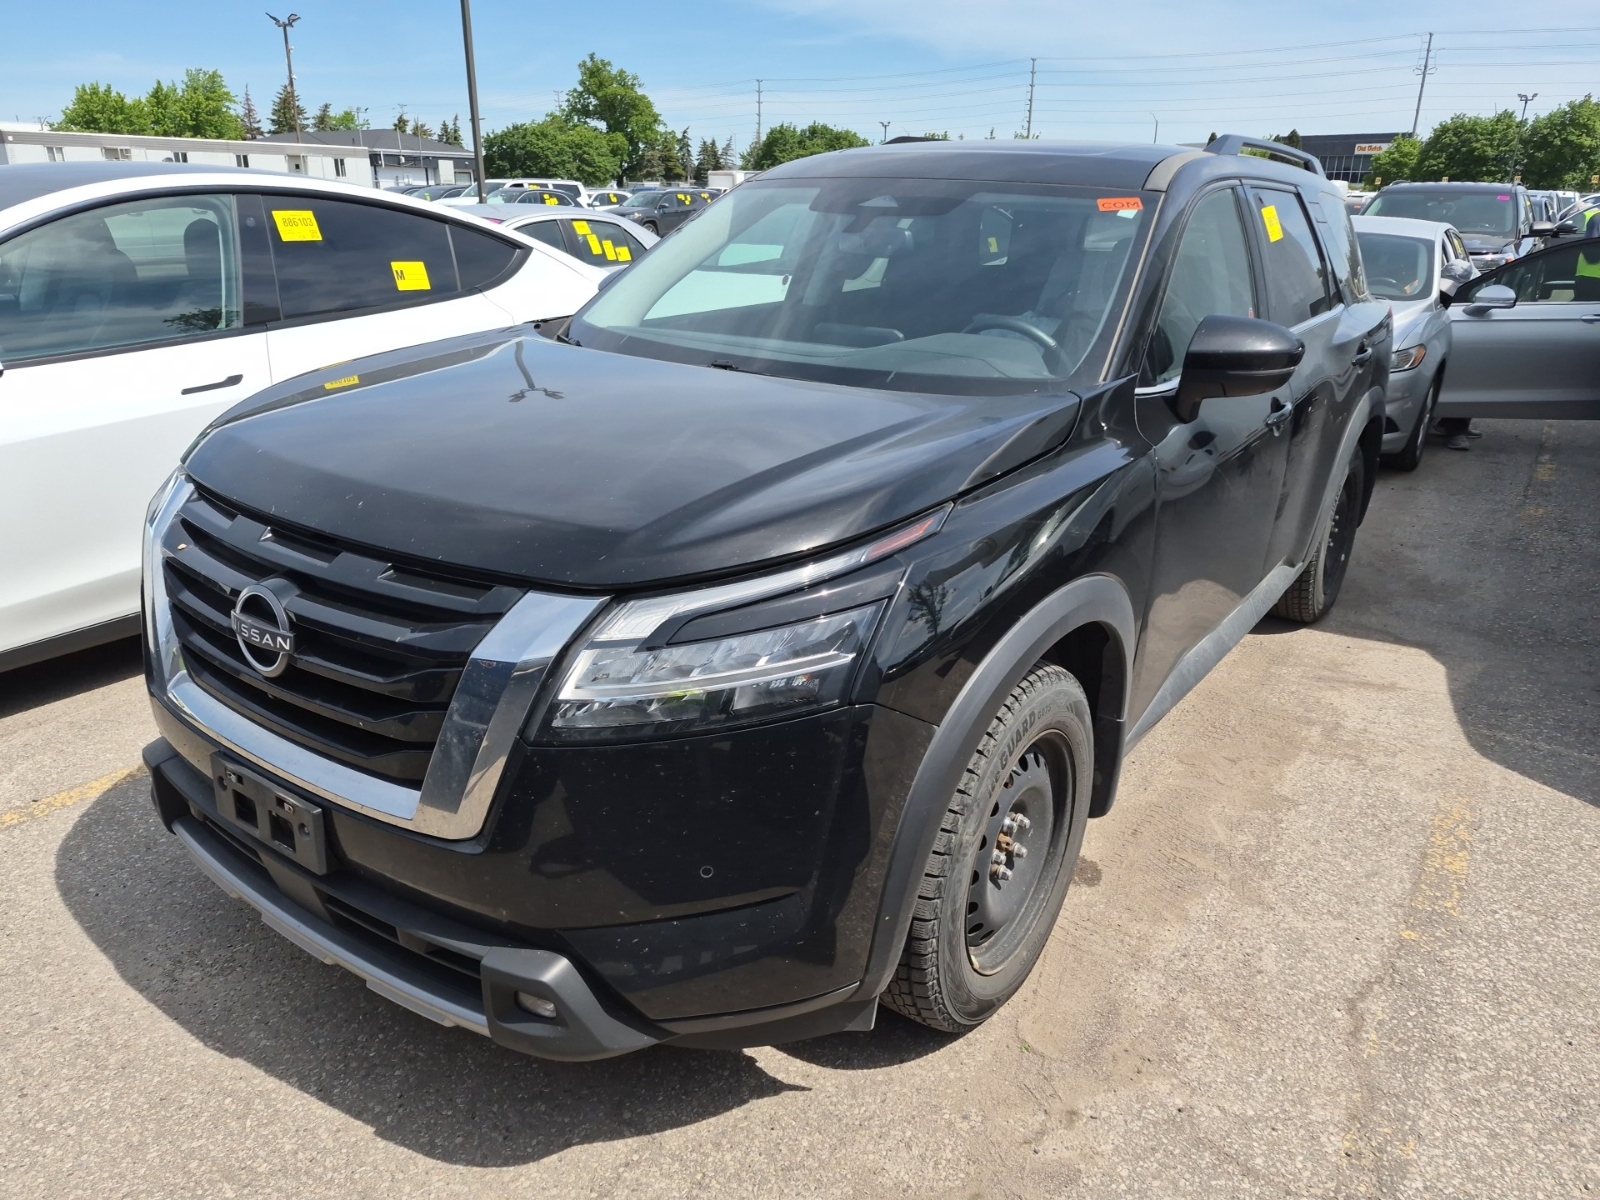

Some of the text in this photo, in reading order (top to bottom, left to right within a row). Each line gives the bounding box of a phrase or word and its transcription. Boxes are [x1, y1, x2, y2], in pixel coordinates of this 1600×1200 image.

[1101, 201, 1140, 209] COM
[281, 217, 314, 227] 886103
[395, 269, 406, 281] M
[231, 617, 291, 651] NISSAN
